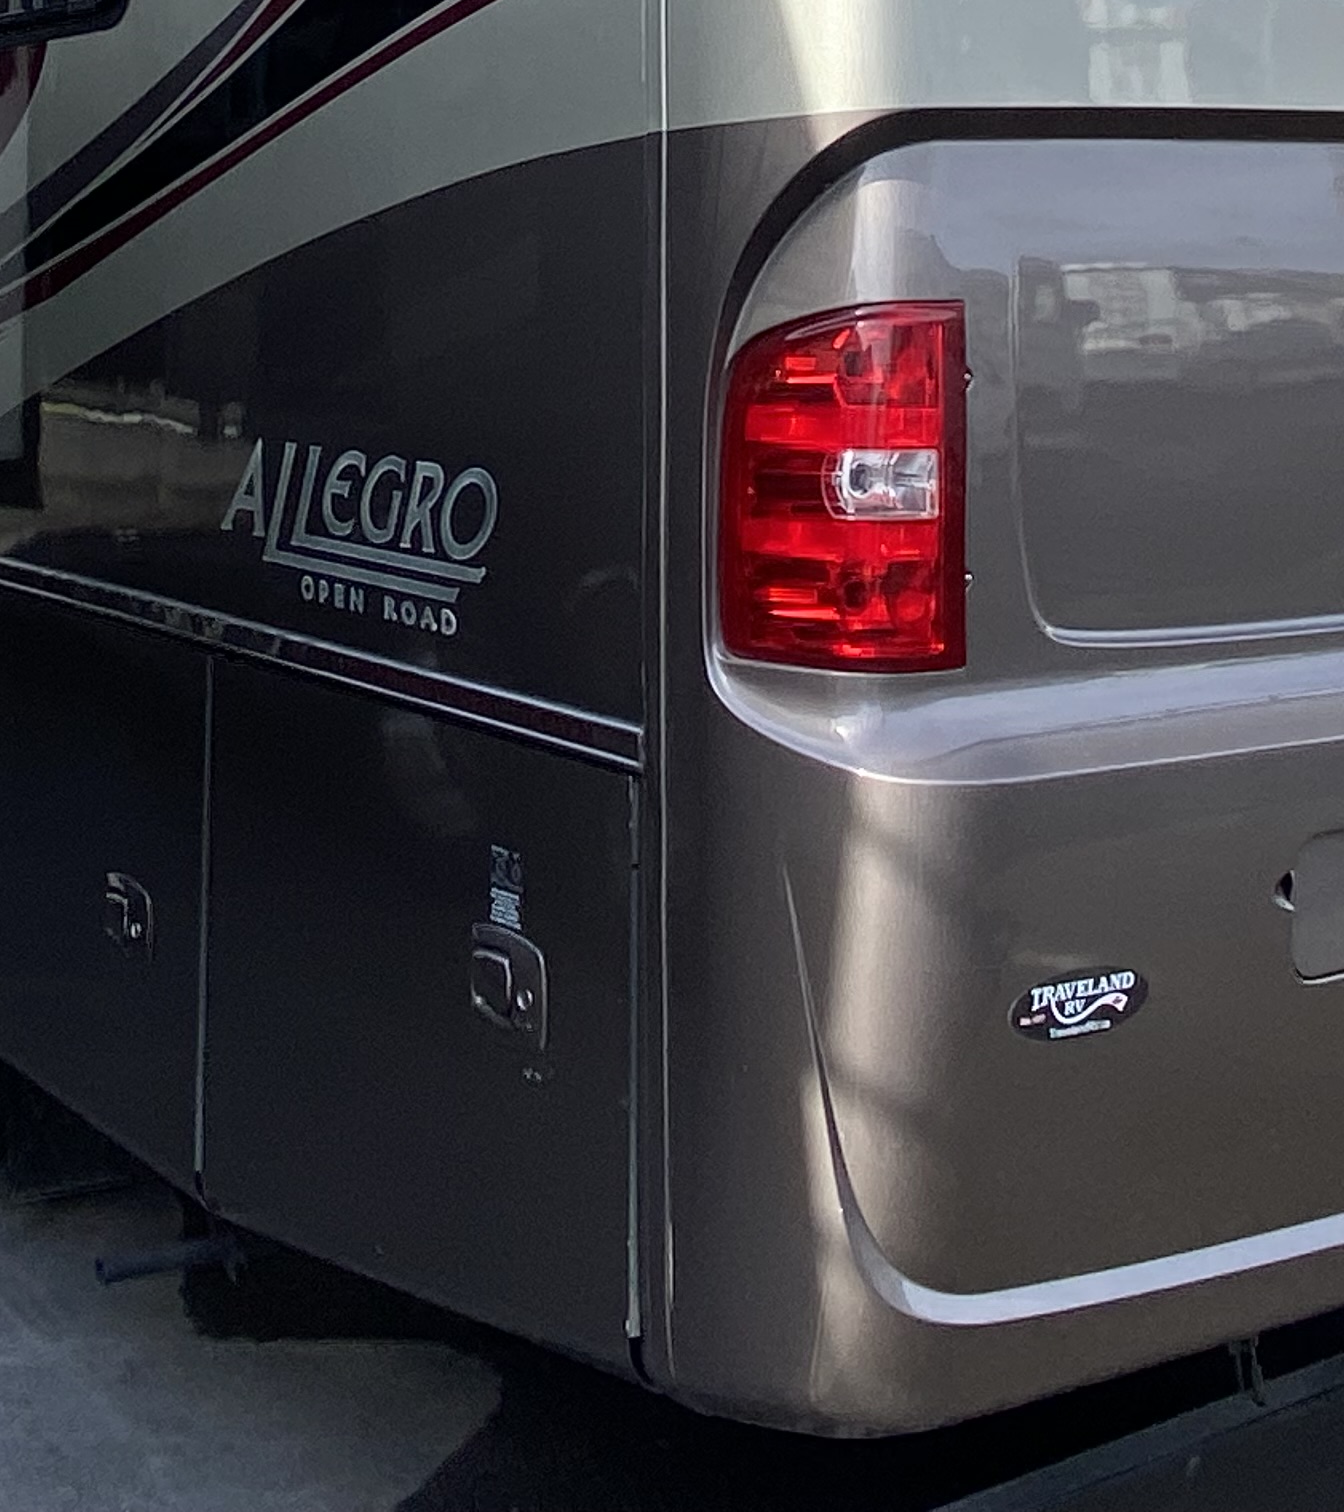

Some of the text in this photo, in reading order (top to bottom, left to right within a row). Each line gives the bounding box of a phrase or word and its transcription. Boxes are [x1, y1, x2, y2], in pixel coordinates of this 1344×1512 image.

[220, 437, 498, 603] ALLEGRO
[300, 574, 457, 636] OPEN ROAD
[1030, 970, 1136, 1012] TRAVELAND
[1063, 998, 1087, 1017] RV
